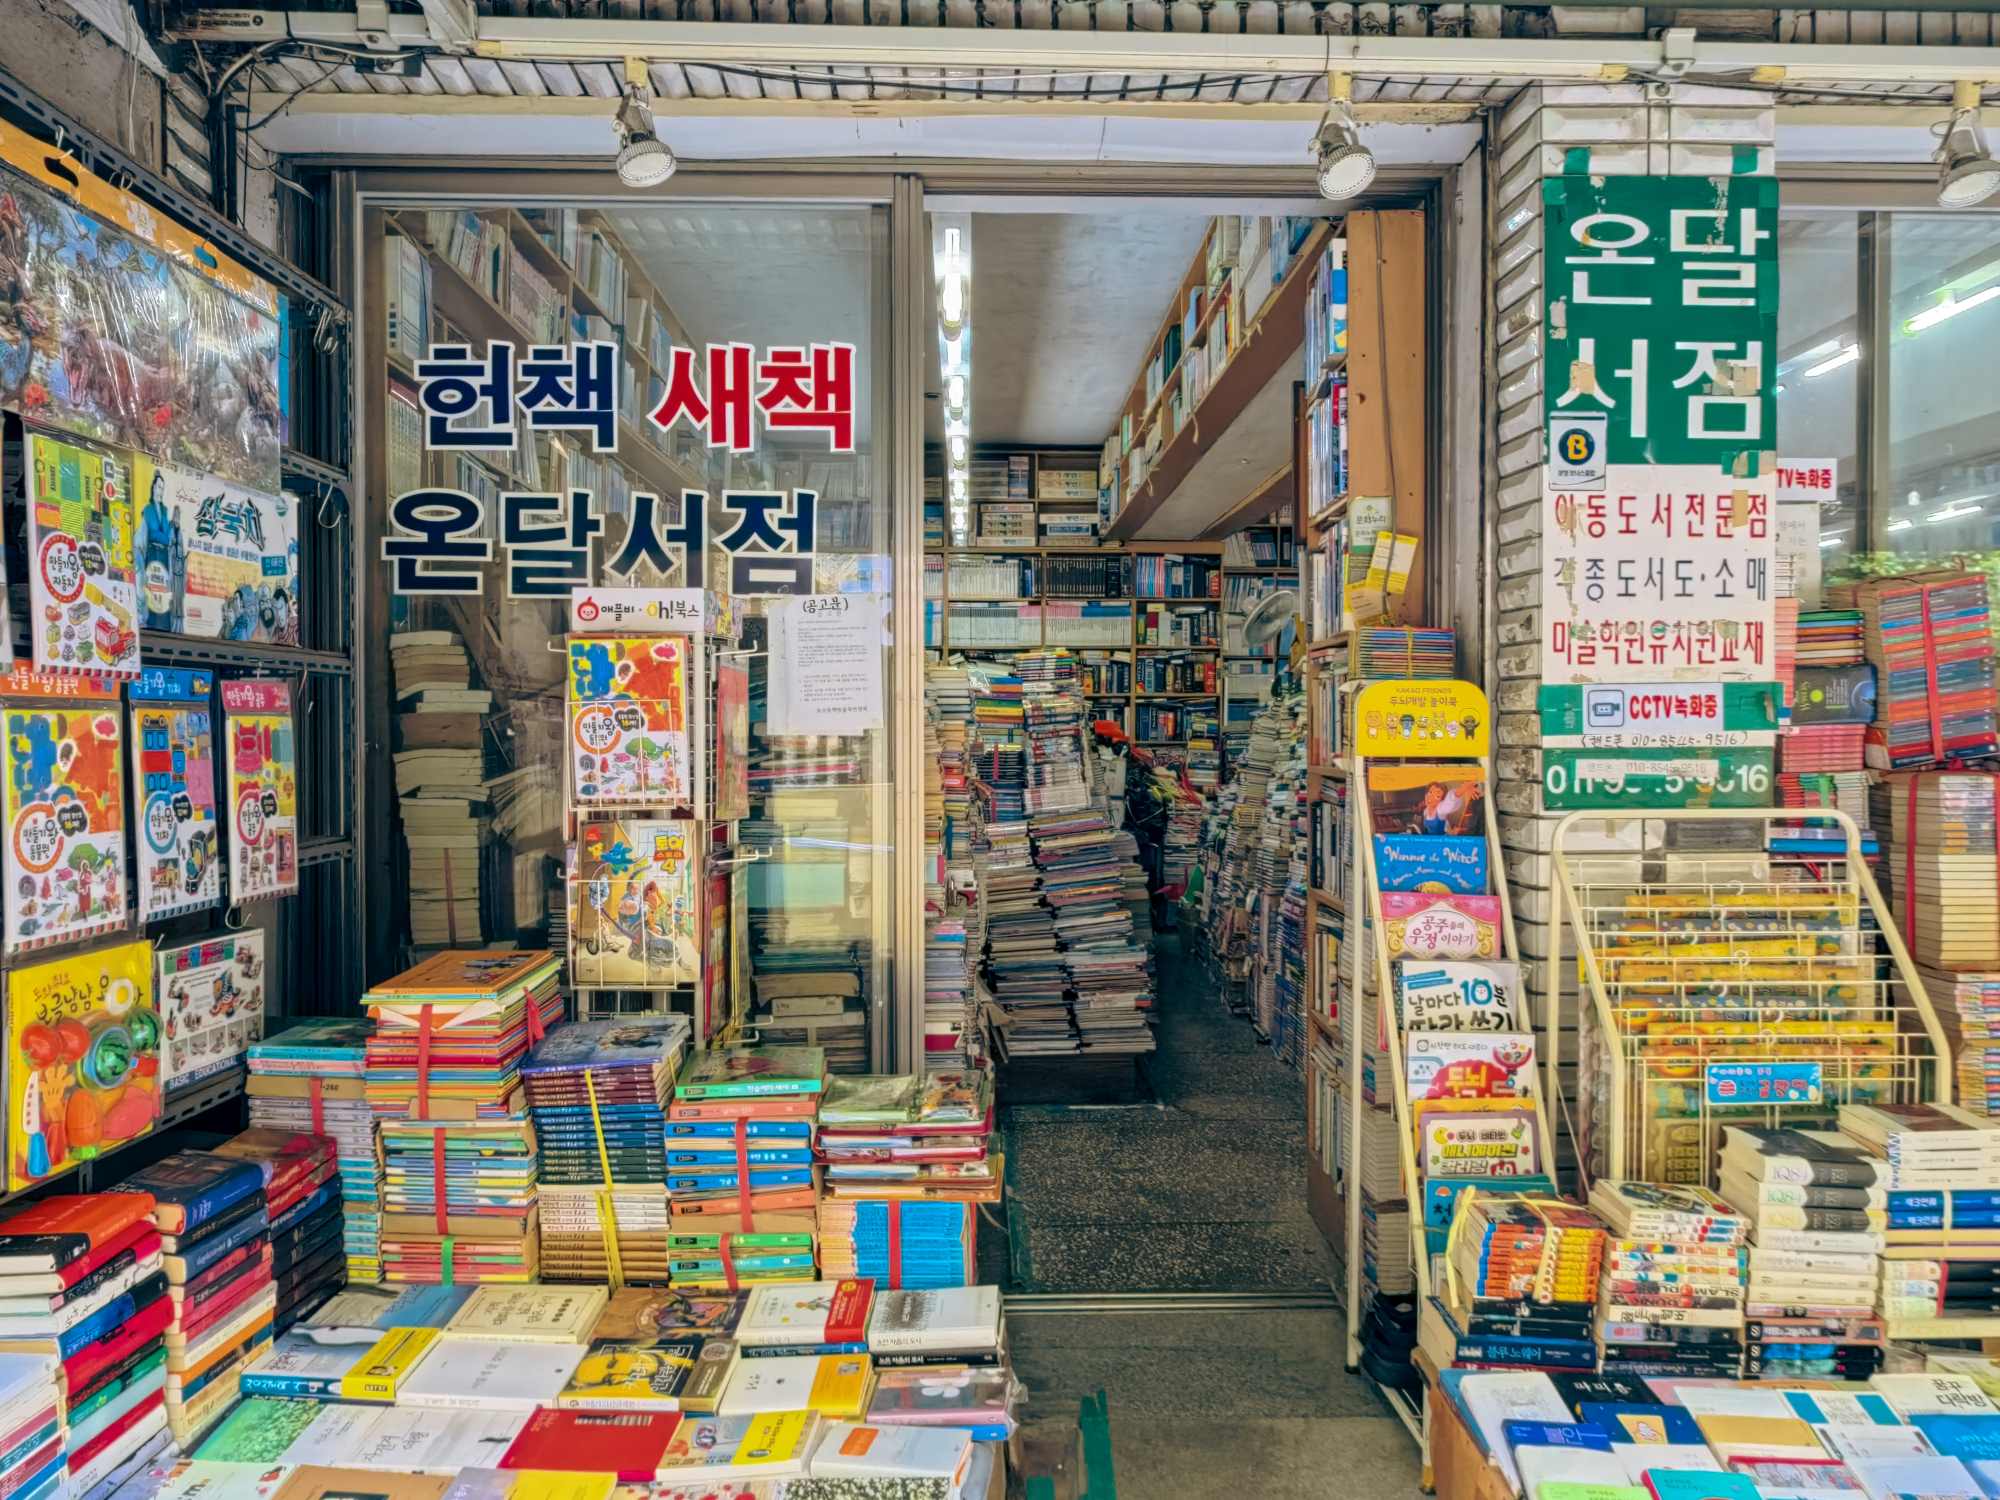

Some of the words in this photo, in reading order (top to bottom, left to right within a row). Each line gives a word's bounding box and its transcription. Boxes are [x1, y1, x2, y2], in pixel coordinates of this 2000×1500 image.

[1565, 208, 1770, 306] 온달
[414, 339, 619, 453] 헌책
[646, 341, 855, 453] 새책
[1556, 338, 1762, 439] 서점
[1555, 494, 1768, 538] 아동도서전문점
[381, 488, 818, 599] 온달서점
[601, 603, 634, 621] 애플비
[1553, 620, 1764, 666] 미술학원유치원교재
[1630, 694, 1717, 720] CCTV녹화중
[1443, 846, 1479, 864] Witch
[1409, 928, 1437, 949] 우정
[1441, 933, 1474, 945] 이야기
[1408, 992, 1461, 1016] 날마다
